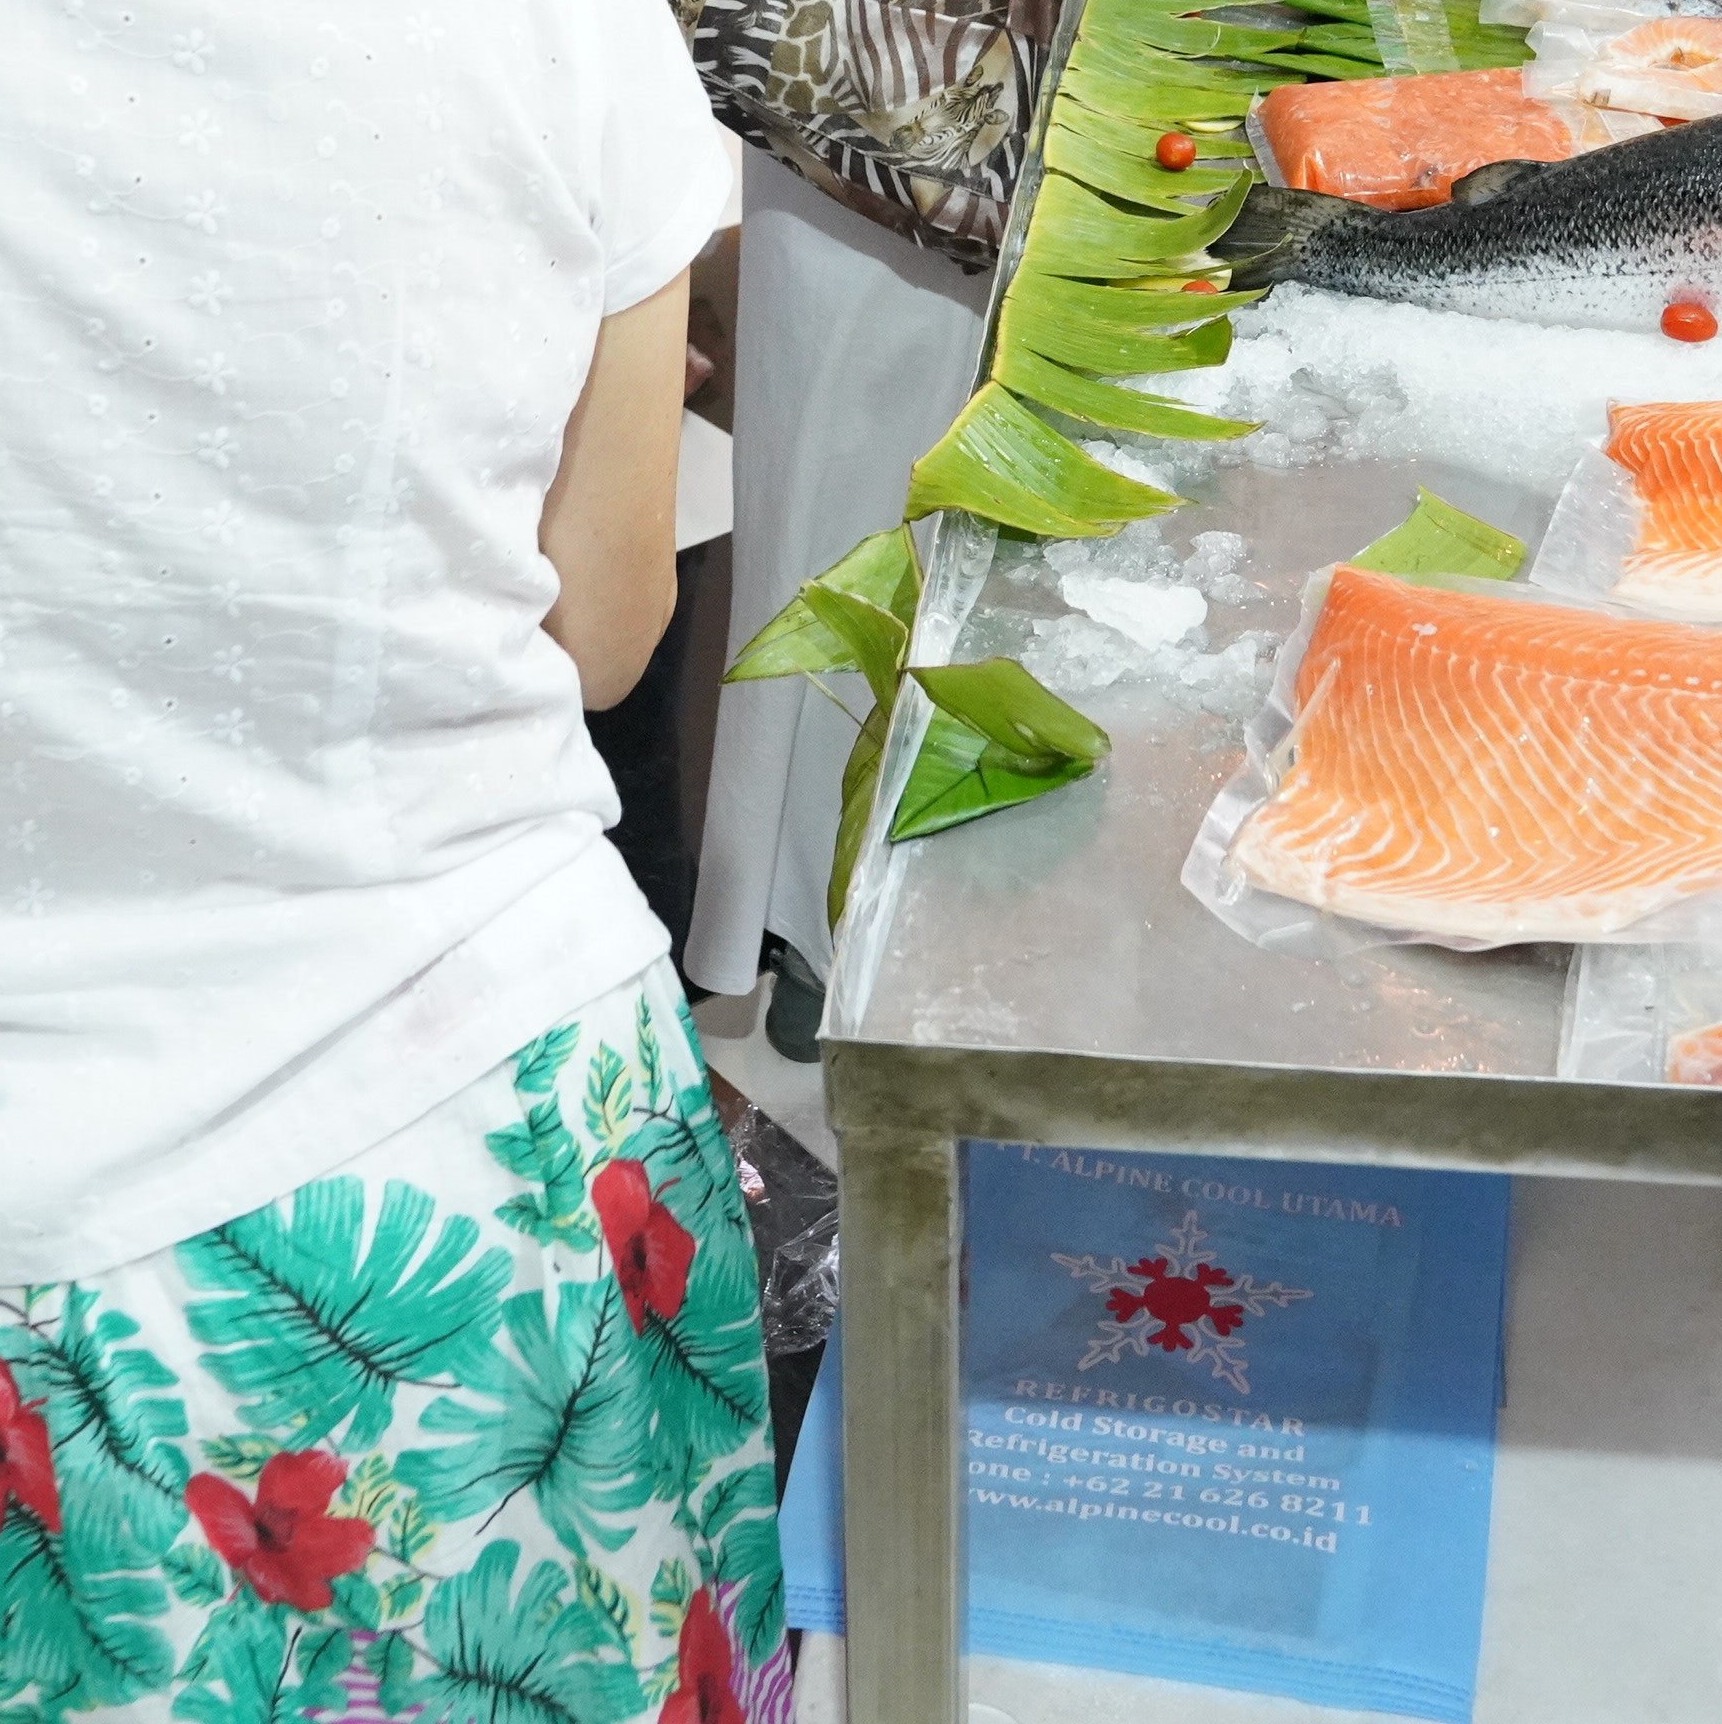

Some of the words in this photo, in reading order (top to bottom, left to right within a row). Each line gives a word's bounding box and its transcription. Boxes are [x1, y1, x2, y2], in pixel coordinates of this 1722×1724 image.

[993, 1142, 1041, 1164] T.
[1050, 1150, 1172, 1194] ALPINE
[1181, 1178, 1270, 1209] COOL
[1281, 1191, 1404, 1227] UTAMA
[1004, 1406, 1083, 1432] Cold
[1092, 1416, 1229, 1455] Storage
[1237, 1437, 1306, 1463] and
[1012, 1378, 1306, 1437] REFRIGOSTAR
[1063, 1475, 1130, 1496] +62
[1143, 1480, 1186, 1501] 21
[1199, 1486, 1270, 1509] 626
[1280, 1493, 1373, 1527] 8211
[1211, 1462, 1341, 1492] System
[969, 1487, 1339, 1554] ww.alpinecool.co.id
